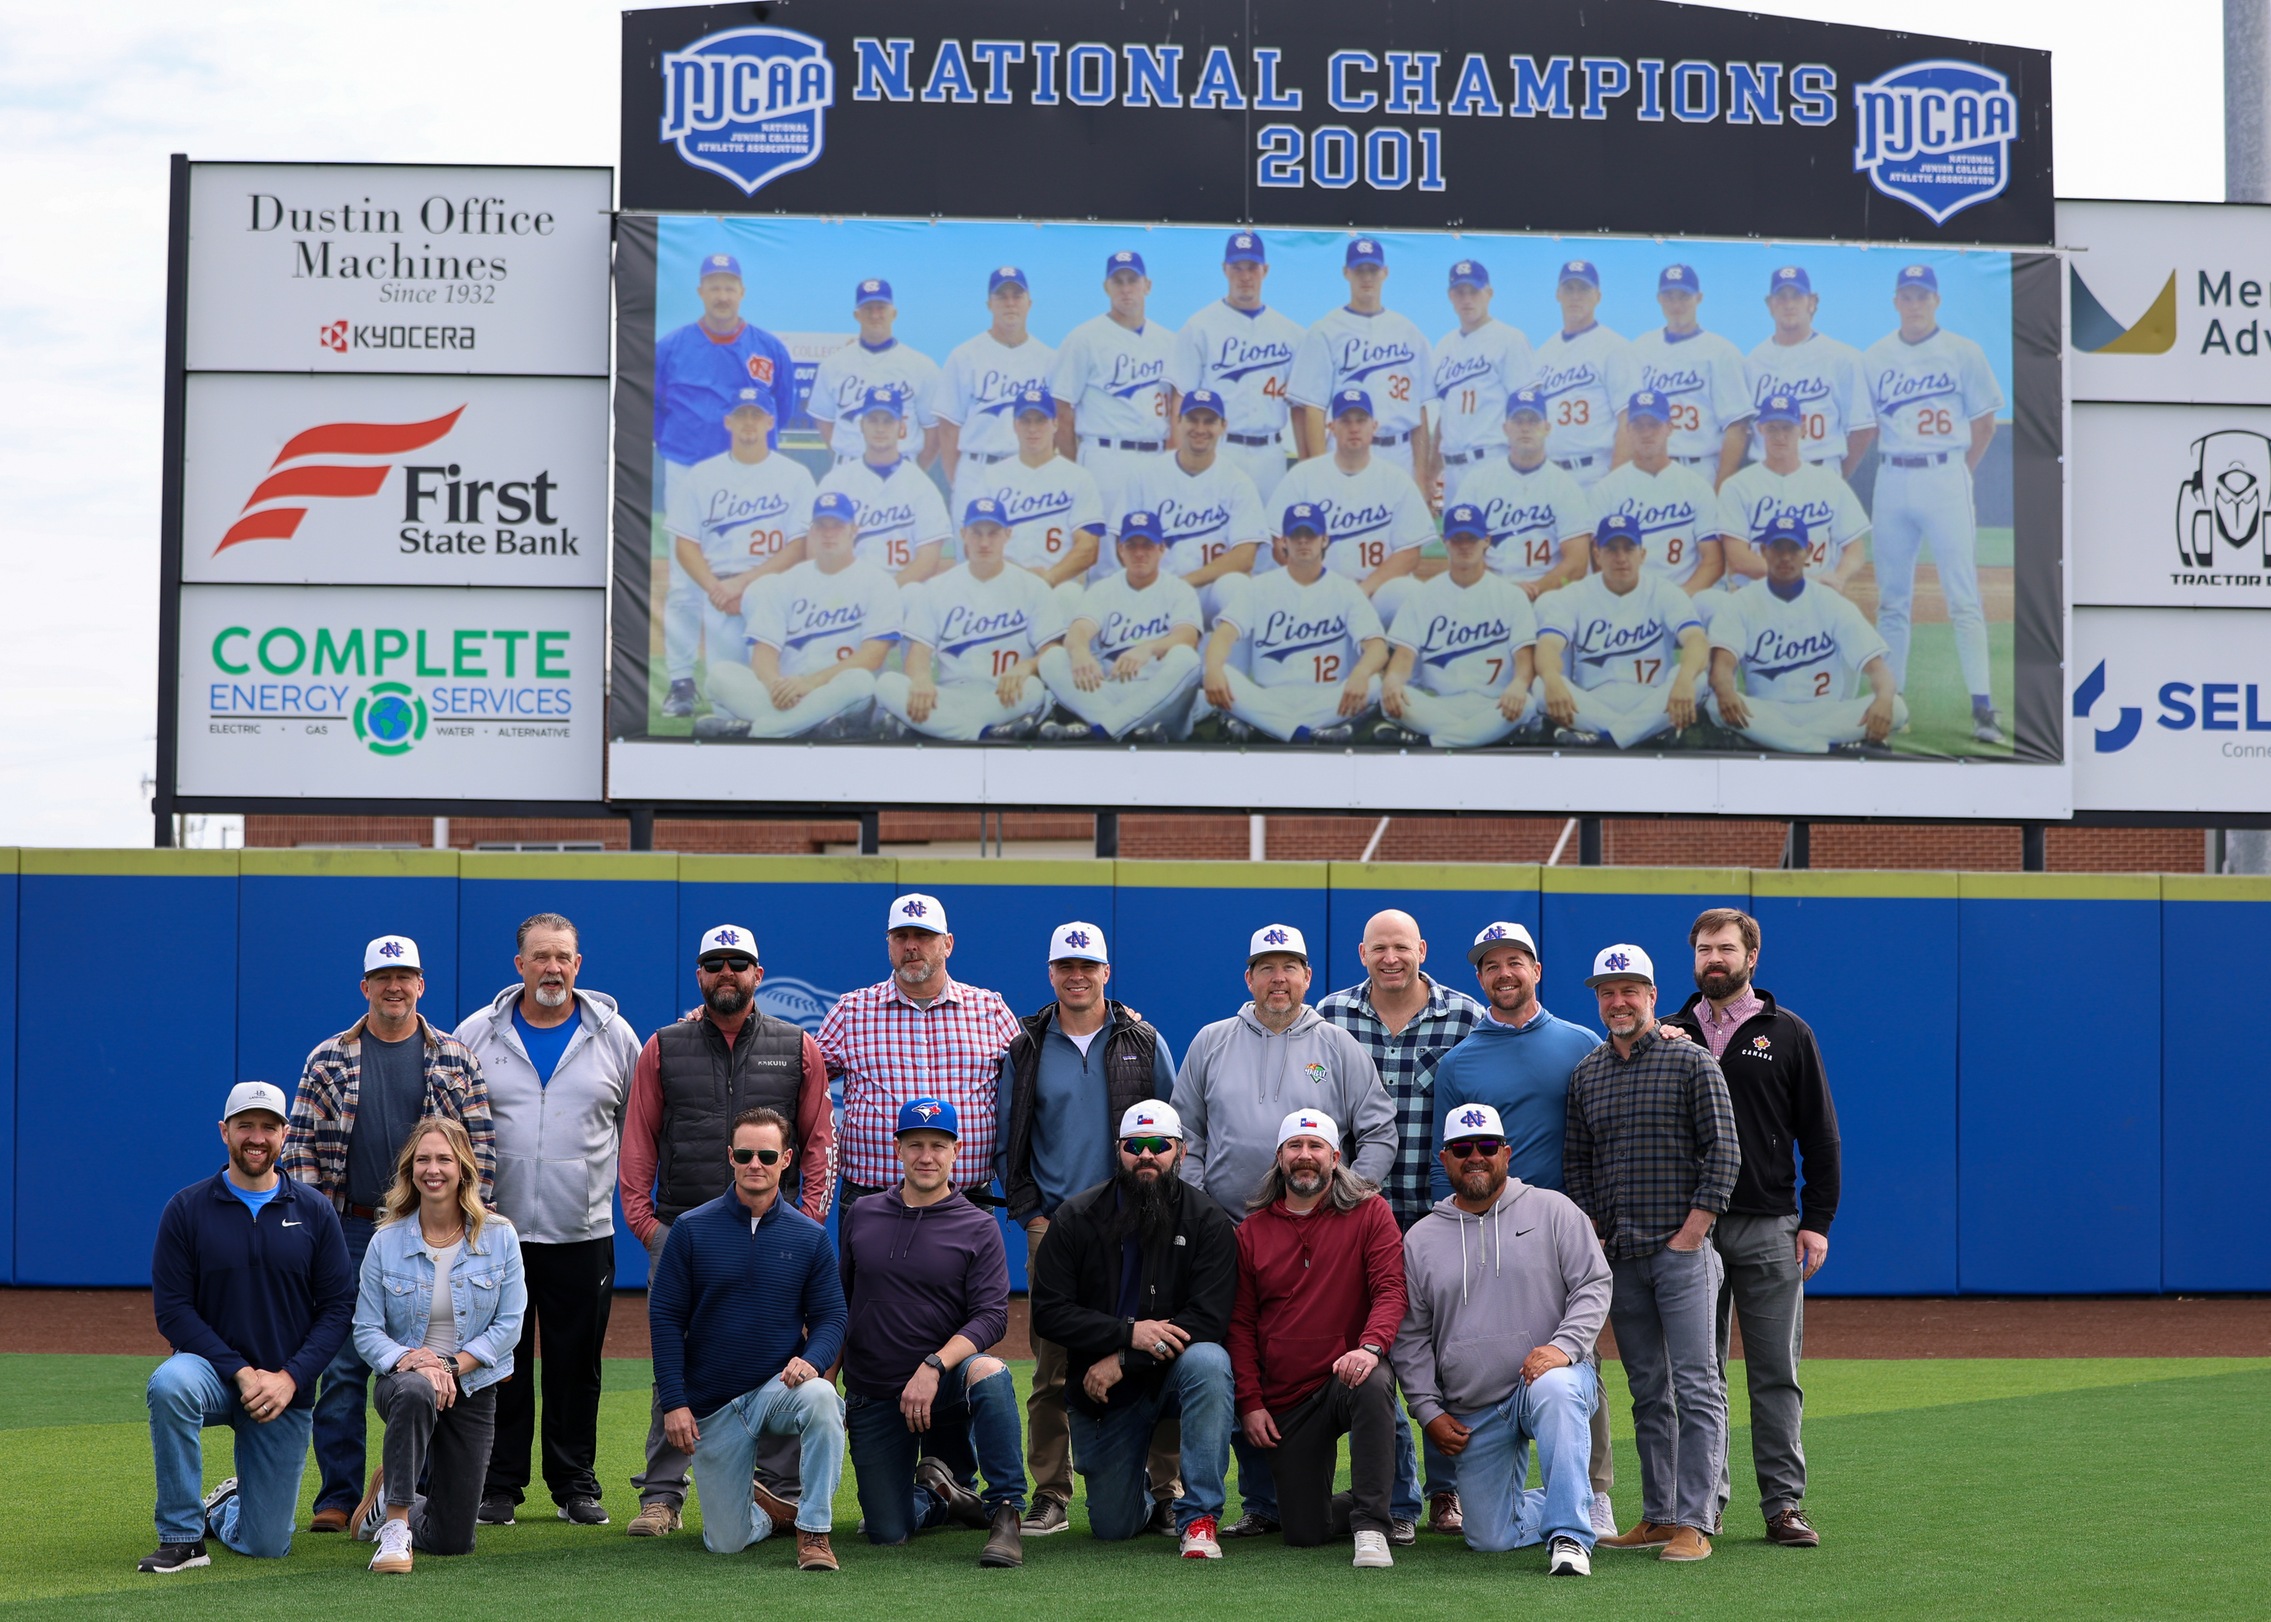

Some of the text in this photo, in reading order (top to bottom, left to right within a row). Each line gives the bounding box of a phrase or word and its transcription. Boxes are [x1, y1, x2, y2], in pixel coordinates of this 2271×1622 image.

[853, 38, 1838, 126] NATIONAL CHAMPIONS
[730, 133, 809, 143] JUNIOR COLLEGE
[761, 123, 809, 133] NATIONAL
[697, 143, 809, 154] ATHLETIC ASSOCIATION
[1257, 125, 1446, 192] 2001
[1949, 155, 1995, 164] NATIONAL
[1890, 173, 1995, 185] ATHLETIC ASSOCIATION
[1920, 164, 1995, 175] JUNIOR COLLEGE
[246, 194, 555, 236] Dustin Office
[291, 241, 508, 282] Machines
[379, 283, 496, 305] Since 1932
[2198, 270, 2271, 308] Me
[354, 326, 475, 350] KYOCERA
[1212, 337, 1292, 371] Lions
[1338, 338, 1414, 374] Lions
[1104, 354, 1164, 389] Lion
[1434, 355, 1491, 390] Lions
[1388, 375, 1411, 401] 32
[1755, 374, 1830, 408] Lions
[1878, 370, 1956, 408] Lions
[1461, 390, 1476, 415] 11
[1557, 400, 1589, 426] 33
[1670, 404, 1700, 431] 23
[1917, 409, 1952, 435] 26
[402, 464, 558, 526] First
[702, 489, 789, 527] Lions
[1157, 499, 1230, 532] Lions
[1483, 498, 1556, 531] Lions
[400, 527, 580, 556] State Bank
[750, 530, 783, 556] 20
[886, 540, 910, 566] 15
[1046, 528, 1062, 553] 6
[1525, 540, 1550, 566] 14
[1667, 539, 1683, 564] 8
[1359, 542, 1384, 567] 18
[2170, 574, 2261, 586] TRACTOR
[787, 599, 865, 634] Lions
[940, 606, 1026, 641] Lions
[1255, 611, 1345, 647] Lions
[1420, 615, 1510, 651] Lions
[1577, 619, 1663, 653] Lions
[1745, 630, 1834, 663] Lions
[212, 627, 571, 678] COMPLETE
[1313, 655, 1340, 682] 12
[1486, 659, 1503, 685] 7
[1634, 659, 1661, 684] 17
[1814, 672, 1831, 697] 2
[210, 684, 572, 714] ENERGY SERVICES
[2157, 682, 2271, 731] SEL
[210, 725, 570, 738] ELECTRIC GAS WATER ALTERNATIVE
[1742, 1049, 1773, 1061] CANADA
